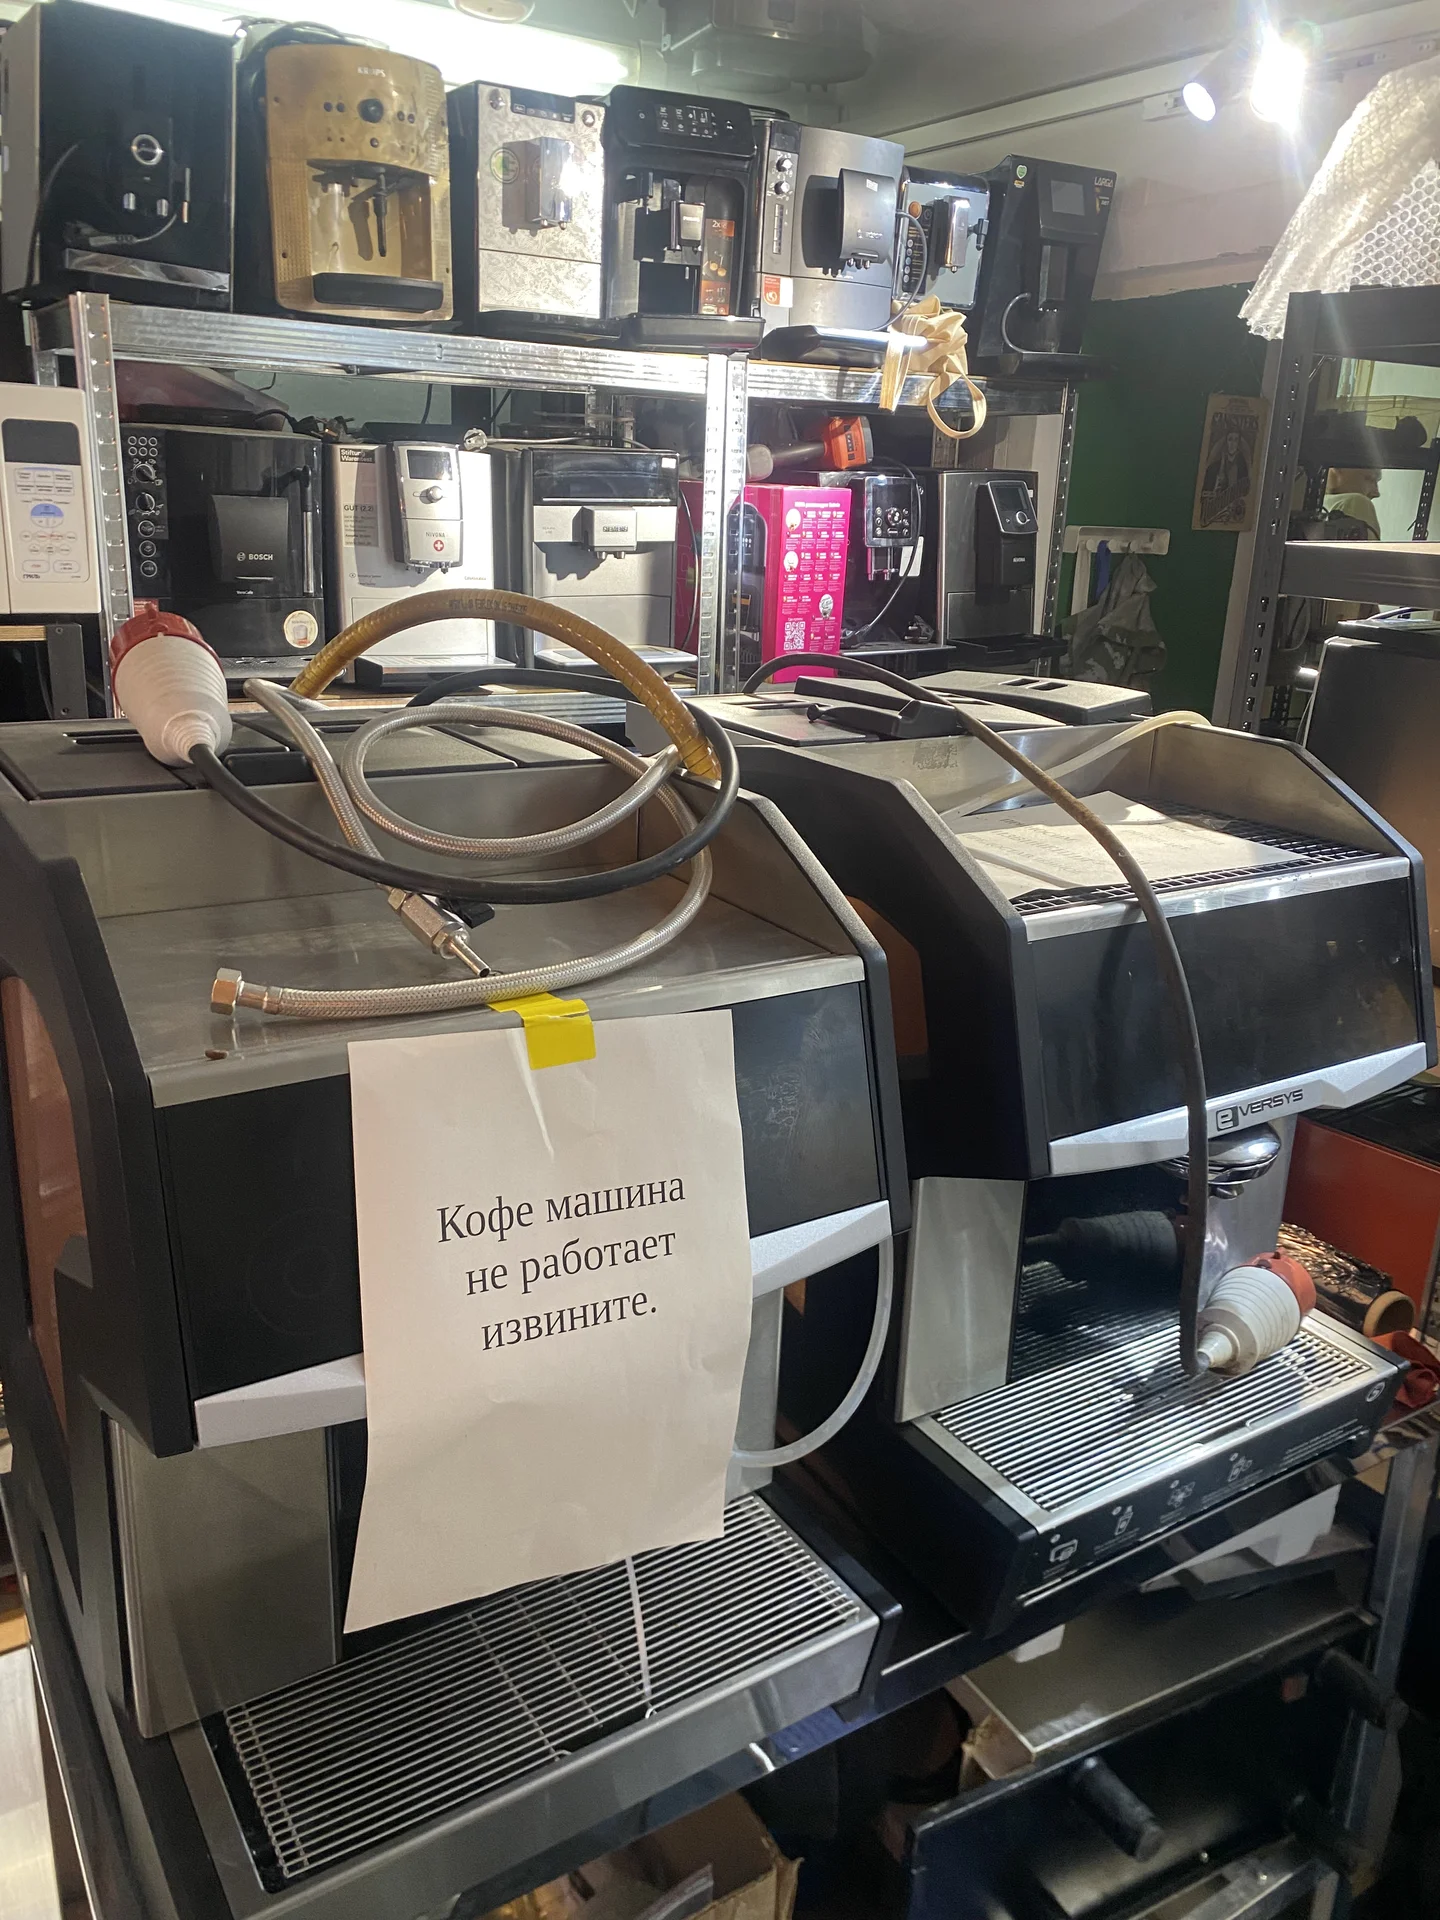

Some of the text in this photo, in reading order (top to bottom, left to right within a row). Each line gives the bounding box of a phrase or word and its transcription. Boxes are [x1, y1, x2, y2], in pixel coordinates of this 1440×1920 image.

[1094, 176, 1114, 188] LARGA
[248, 553, 274, 561] BOSCH
[436, 1176, 686, 1243] Кофе машина
[465, 1231, 676, 1296] не работает
[481, 1290, 657, 1351] извините.
